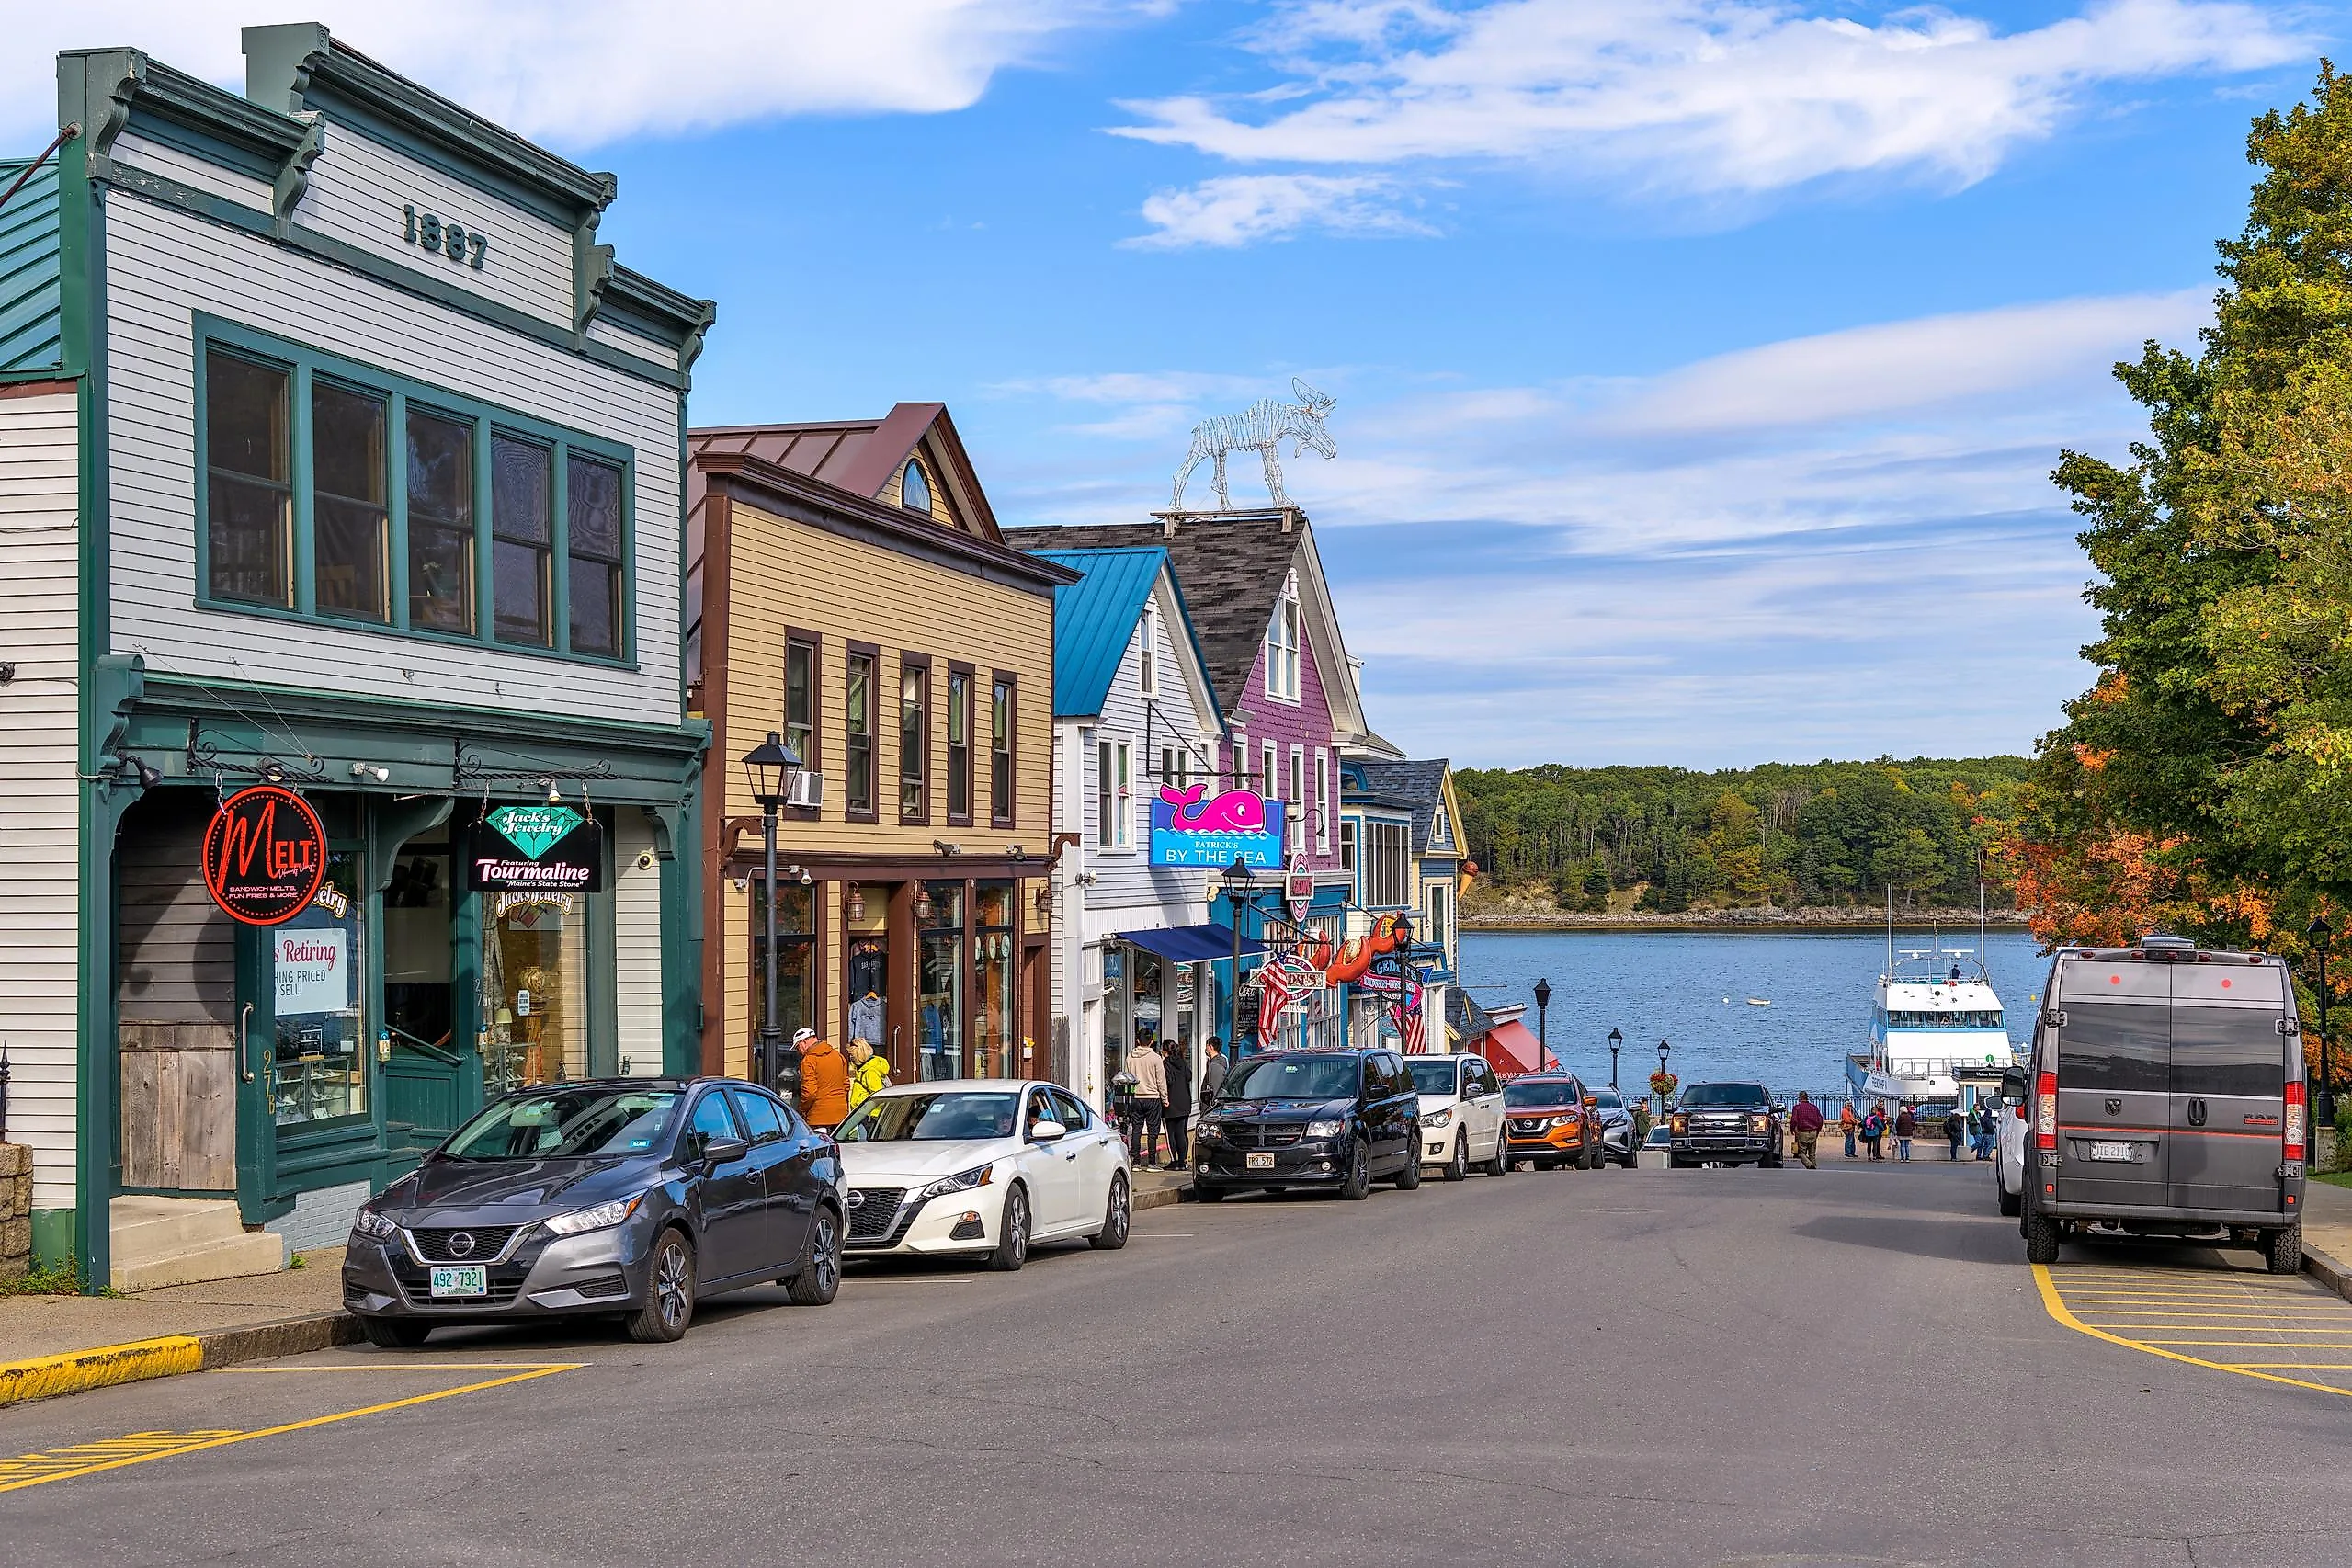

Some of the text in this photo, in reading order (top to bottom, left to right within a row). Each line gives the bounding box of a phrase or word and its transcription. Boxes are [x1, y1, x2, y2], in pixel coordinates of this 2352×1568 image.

[404, 204, 488, 269] 1887
[503, 812, 551, 824] Jack's
[503, 822, 563, 835] Jewelry
[1194, 841, 1239, 849] PATRICK'S
[1165, 849, 1188, 862] BY
[1194, 850, 1228, 863] THE
[475, 858, 590, 882] Tourmaline
[500, 859, 540, 868] Featuring
[282, 939, 337, 971] Retiring
[297, 970, 326, 983] PRICED
[279, 983, 302, 996] SELL!
[433, 1271, 483, 1287] 492 7321
